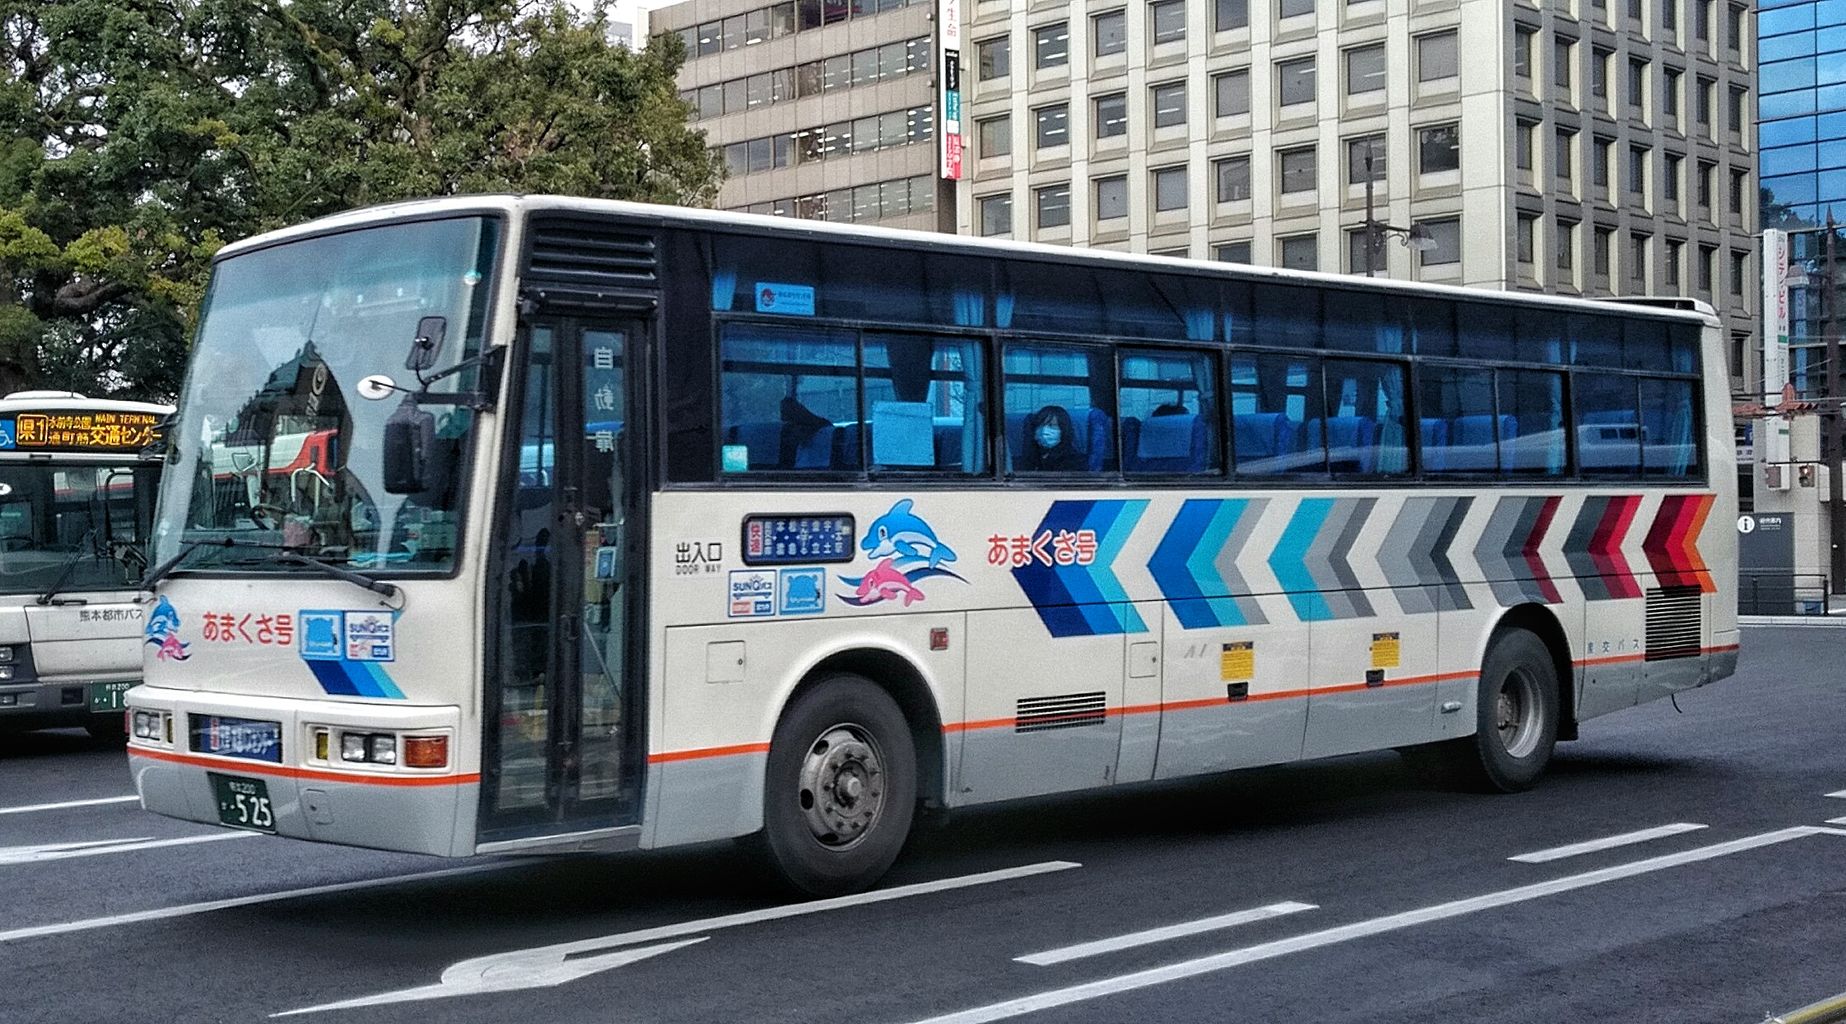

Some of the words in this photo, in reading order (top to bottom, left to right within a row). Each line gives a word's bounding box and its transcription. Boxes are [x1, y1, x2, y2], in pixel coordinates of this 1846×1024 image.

[95, 413, 116, 424] MAIN
[89, 425, 162, 446] 交通センター
[676, 541, 723, 564] 出入口
[987, 532, 1097, 567] あまくさ号
[676, 564, 699, 575] DOOR
[705, 563, 722, 573] WAY
[80, 604, 144, 622] 熊本都市バス
[203, 611, 293, 646] あまくさ号
[235, 793, 272, 827] 525
